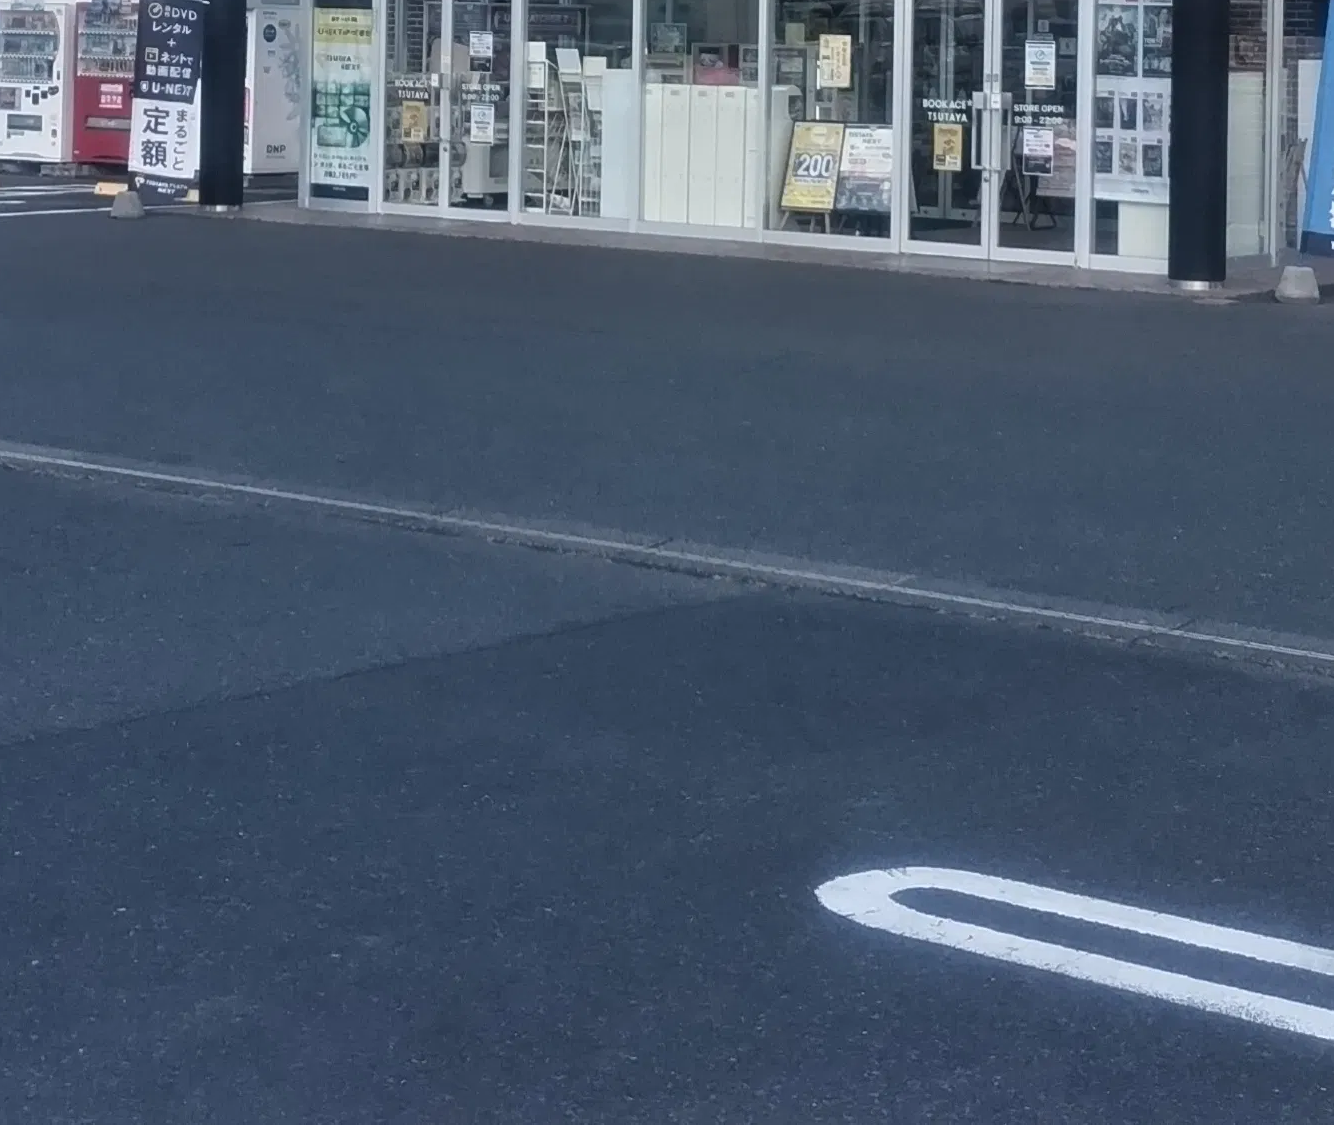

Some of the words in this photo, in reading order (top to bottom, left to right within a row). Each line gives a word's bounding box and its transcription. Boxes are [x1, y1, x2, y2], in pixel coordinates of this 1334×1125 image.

[152, 21, 192, 34] レンタル
[160, 52, 194, 65] ネットで
[146, 64, 192, 79] 動画配信
[151, 82, 193, 96] U-NEXT
[398, 90, 429, 99] TSUTAYA
[922, 99, 948, 108] BOOK
[1014, 104, 1040, 112] STORE
[1041, 105, 1064, 113] OPEN
[927, 112, 967, 122] TSUTAYA
[141, 106, 170, 168] 定額
[172, 109, 188, 171] まるごと
[267, 145, 286, 154] DNP
